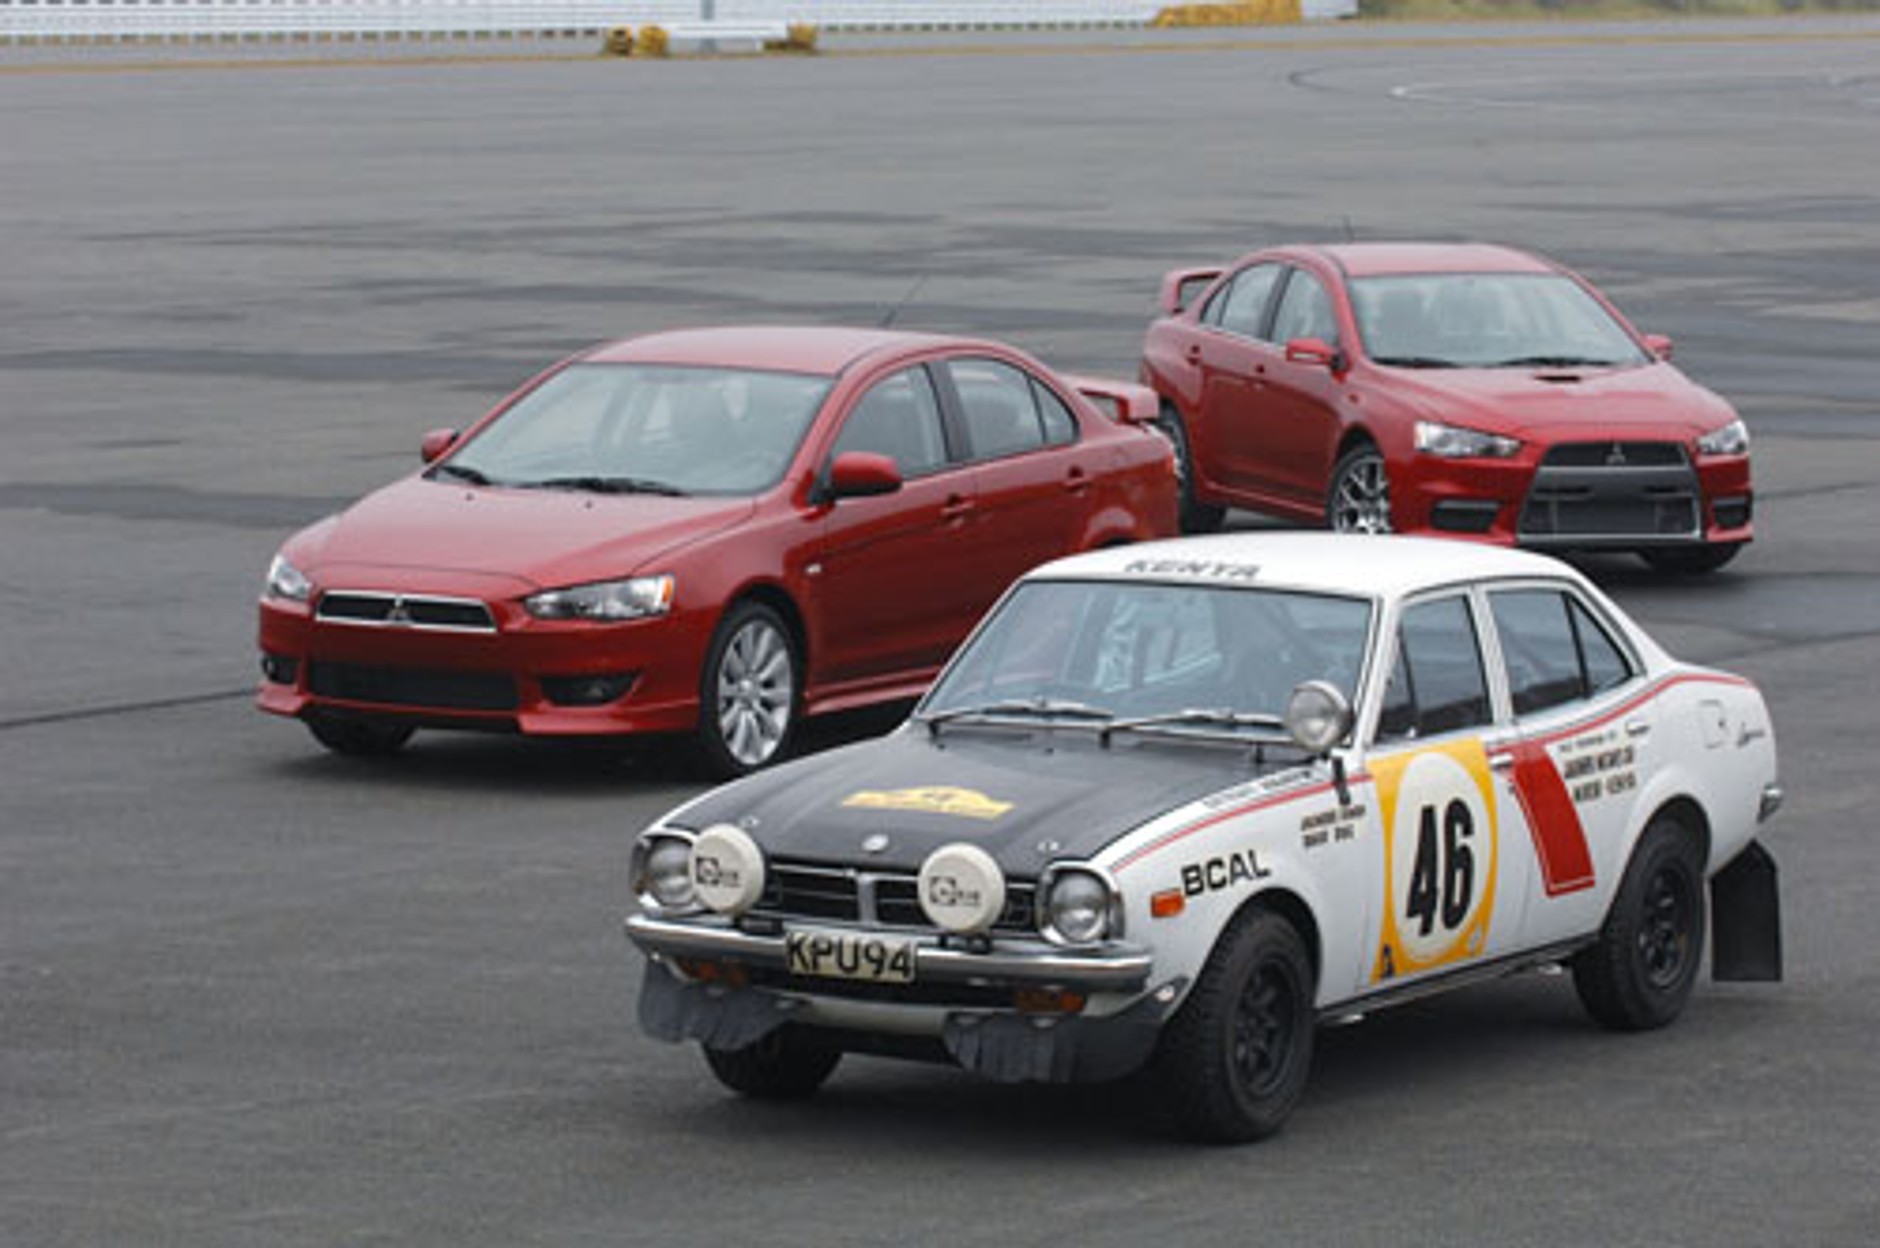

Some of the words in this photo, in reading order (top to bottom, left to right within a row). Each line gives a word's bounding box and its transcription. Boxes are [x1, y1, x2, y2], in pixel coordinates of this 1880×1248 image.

[1181, 849, 1270, 897] BCAL
[1406, 797, 1474, 937] 46
[787, 933, 913, 979] KPU94
